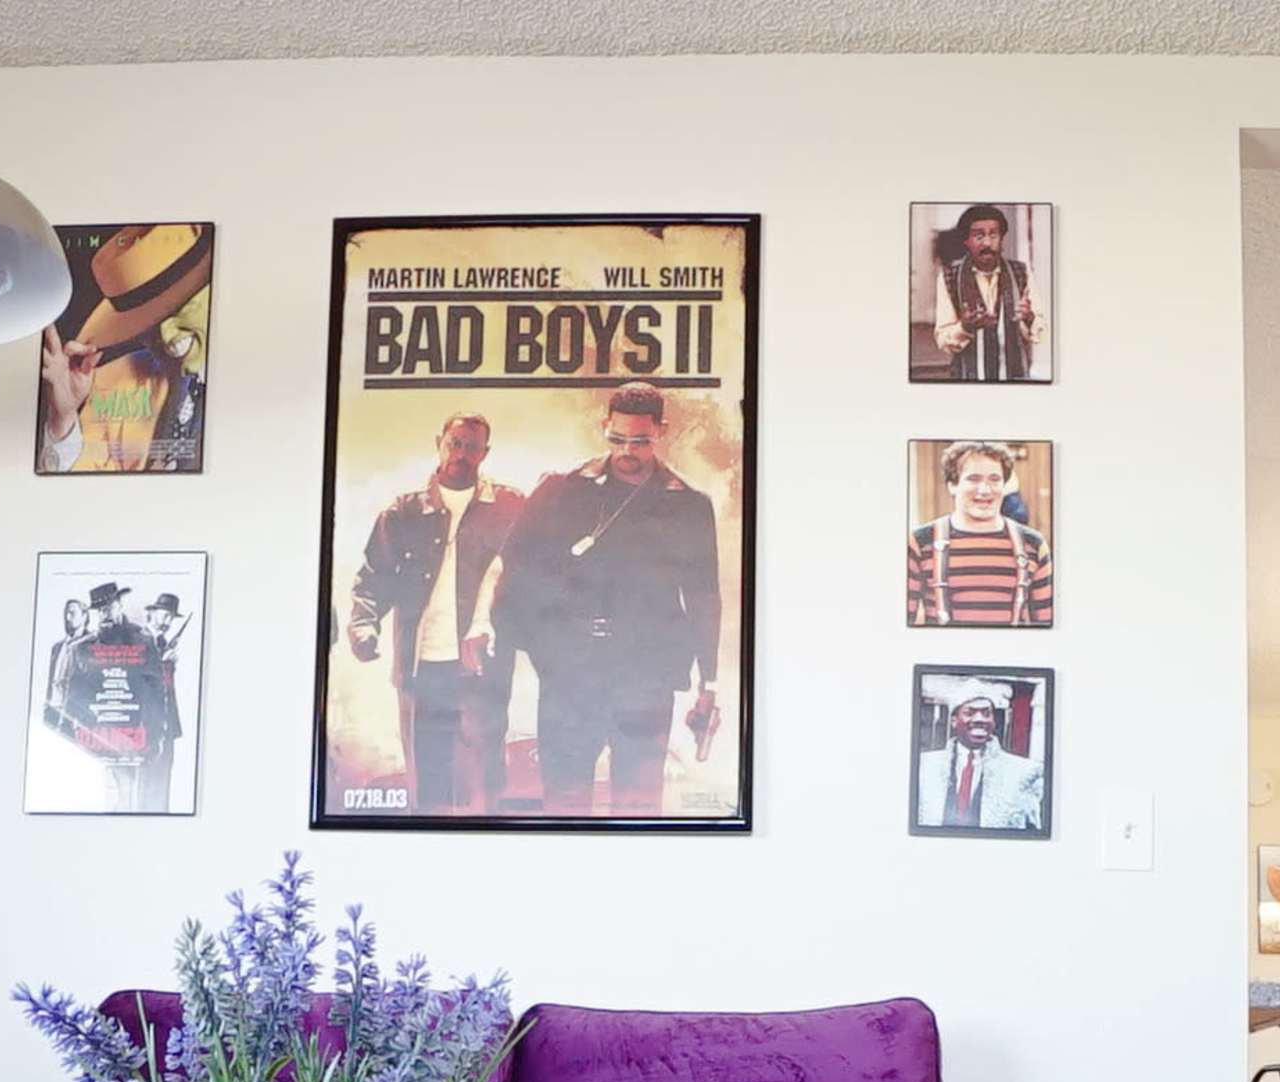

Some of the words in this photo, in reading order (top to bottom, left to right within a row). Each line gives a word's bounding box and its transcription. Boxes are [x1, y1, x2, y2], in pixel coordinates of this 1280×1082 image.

[368, 267, 446, 289] MARTIN
[453, 266, 561, 289] LAWRENCE
[604, 266, 652, 288] WILL
[659, 266, 724, 288] SMITH
[364, 304, 485, 375] BAD
[504, 304, 663, 375] BOYS
[675, 304, 713, 375] II
[344, 788, 408, 809] 07.18.03
